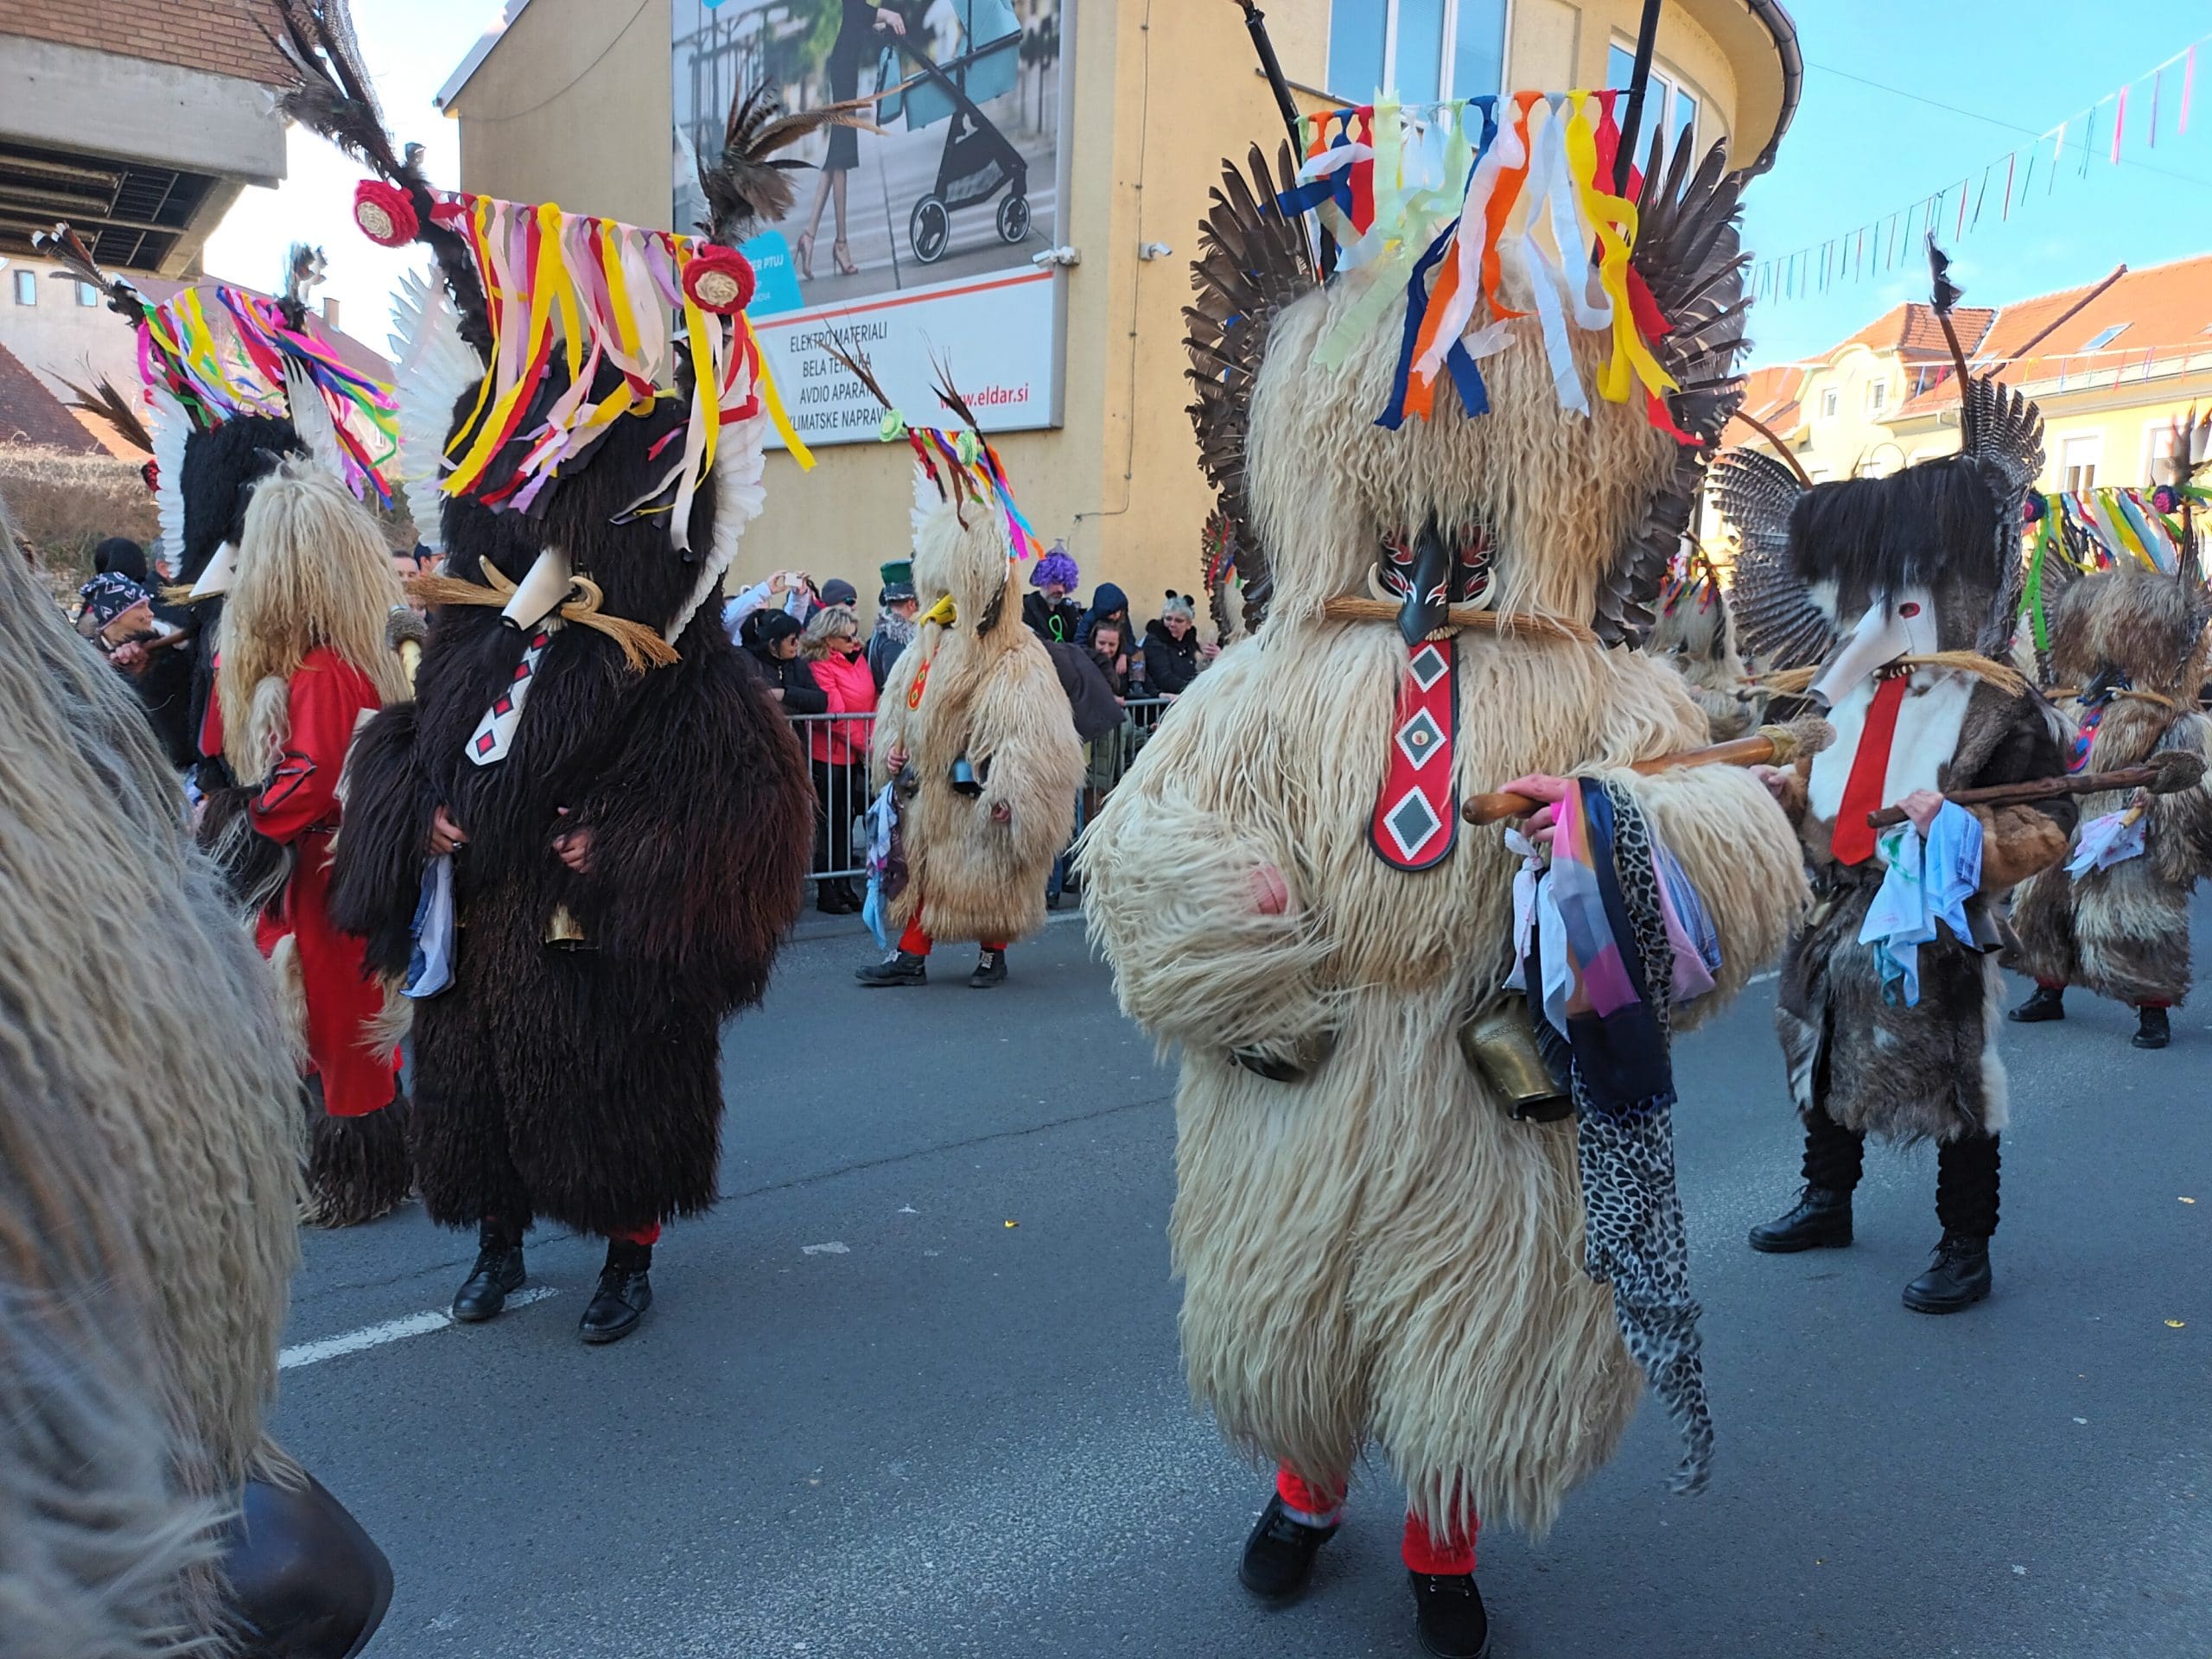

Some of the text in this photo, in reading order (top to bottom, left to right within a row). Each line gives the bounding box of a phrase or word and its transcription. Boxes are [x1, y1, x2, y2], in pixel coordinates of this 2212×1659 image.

[764, 254, 784, 269] PTUJ
[790, 321, 887, 353] ELEKTRO MATERIALI
[803, 359, 827, 378] BELA
[800, 381, 874, 404] AVDIO APARAT
[939, 383, 1028, 410] w.eldar.si
[842, 407, 887, 428] NAPRAV
